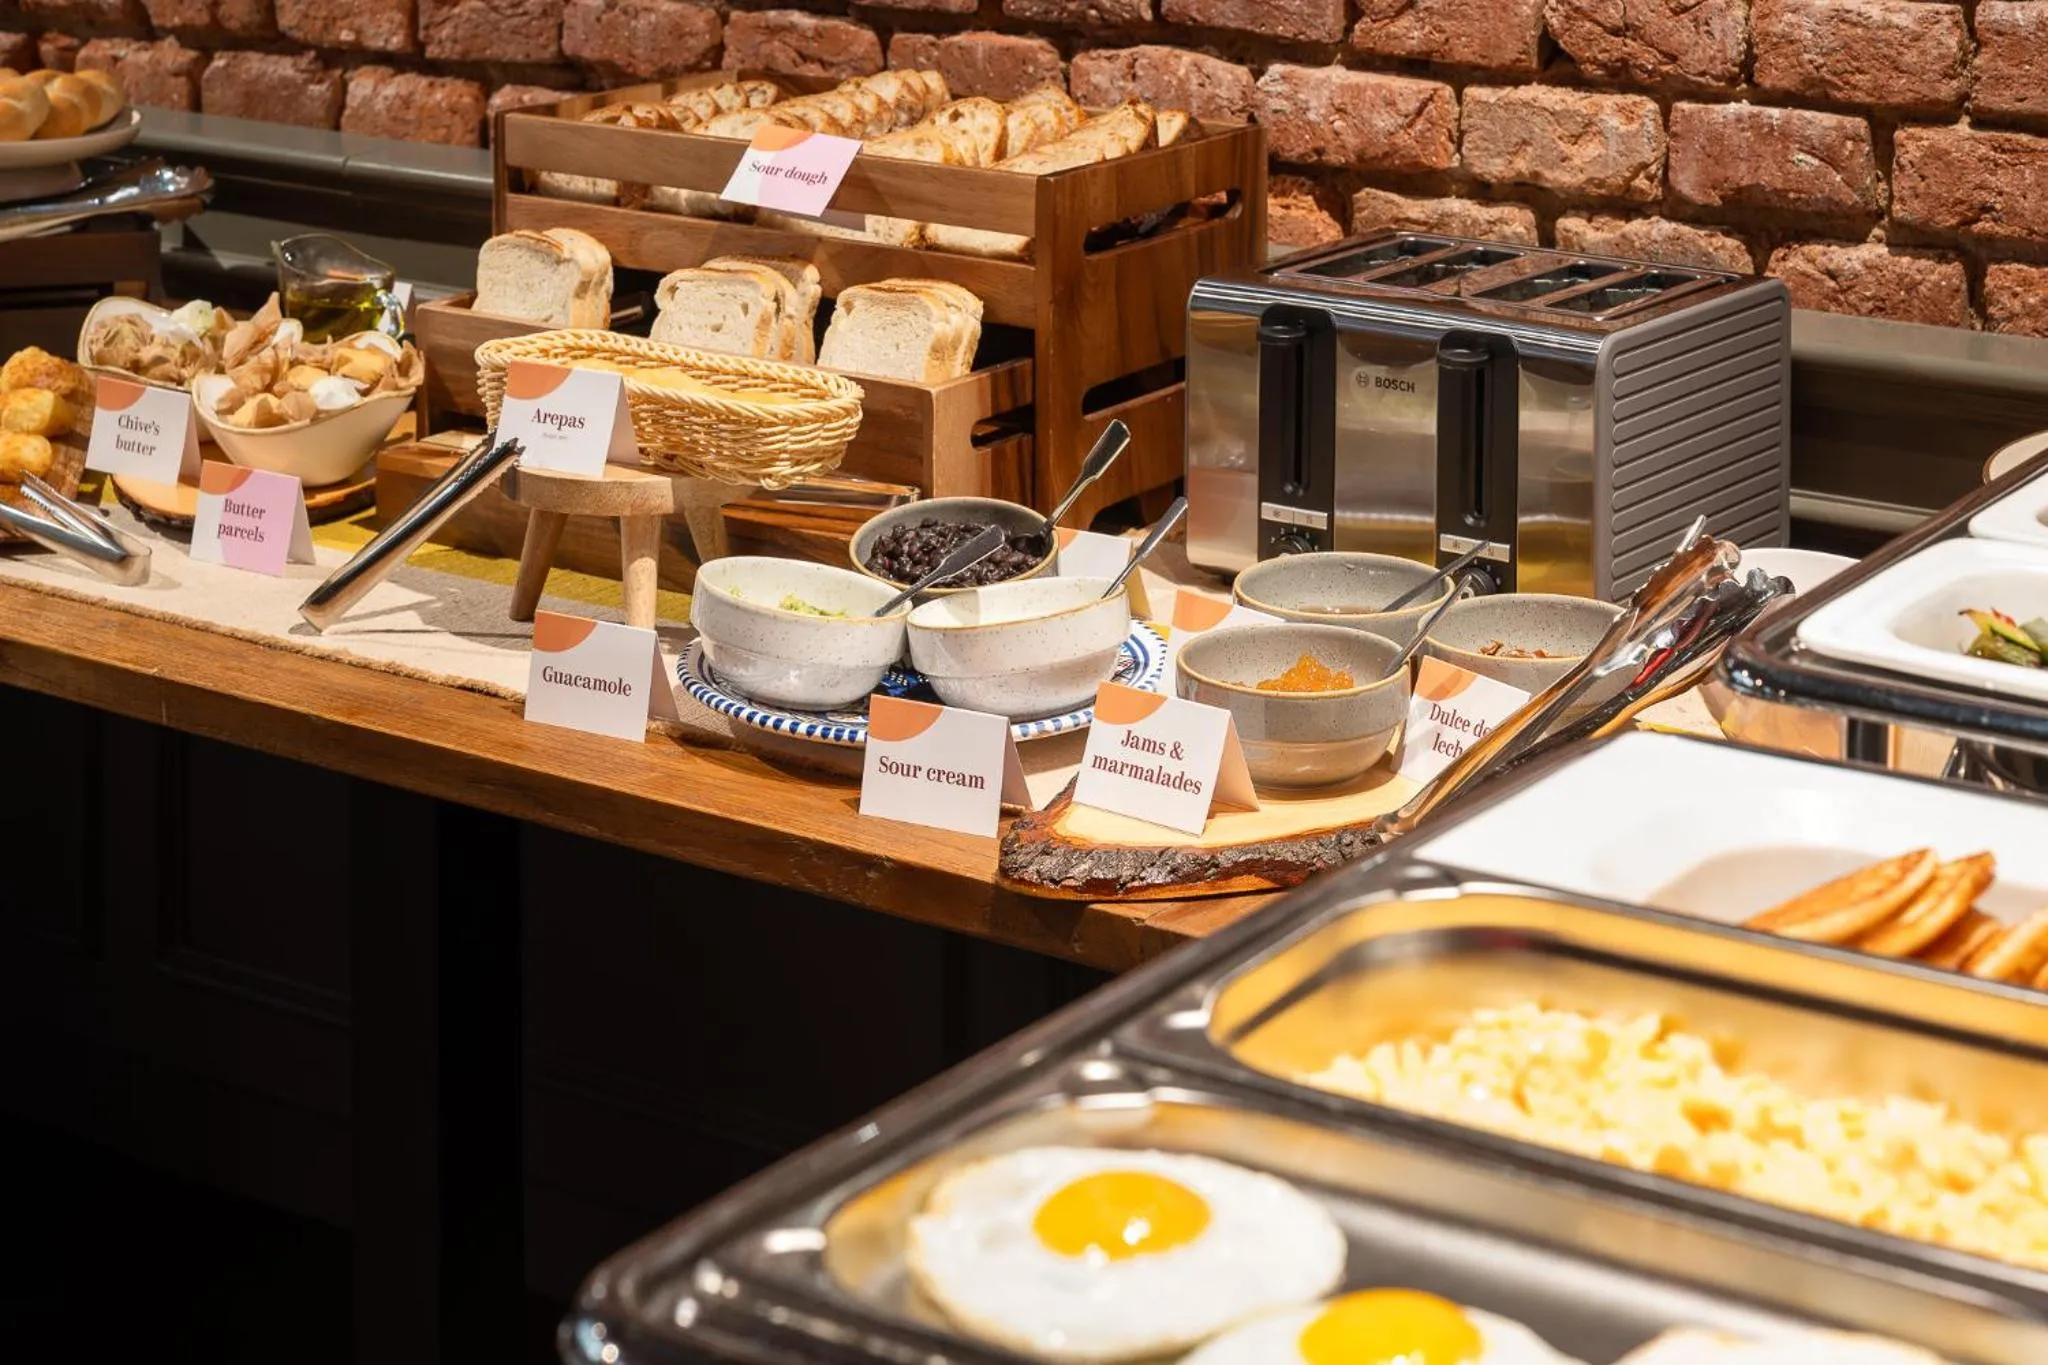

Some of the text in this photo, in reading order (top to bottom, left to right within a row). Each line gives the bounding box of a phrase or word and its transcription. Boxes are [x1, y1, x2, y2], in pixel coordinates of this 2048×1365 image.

[748, 159, 829, 186] Sour dough
[1374, 376, 1416, 394] BOSCH
[117, 414, 161, 436] Chive's
[531, 407, 586, 431] Arepas
[115, 434, 157, 456] butter
[223, 498, 266, 521] Butter
[217, 522, 265, 544] parcels
[542, 665, 632, 697] Guacamole
[1428, 702, 1471, 733] Dulce
[1120, 729, 1185, 761] Jams &
[1432, 732, 1464, 758] lech
[878, 755, 985, 790] Sour cream
[1091, 753, 1203, 795] marmalades
